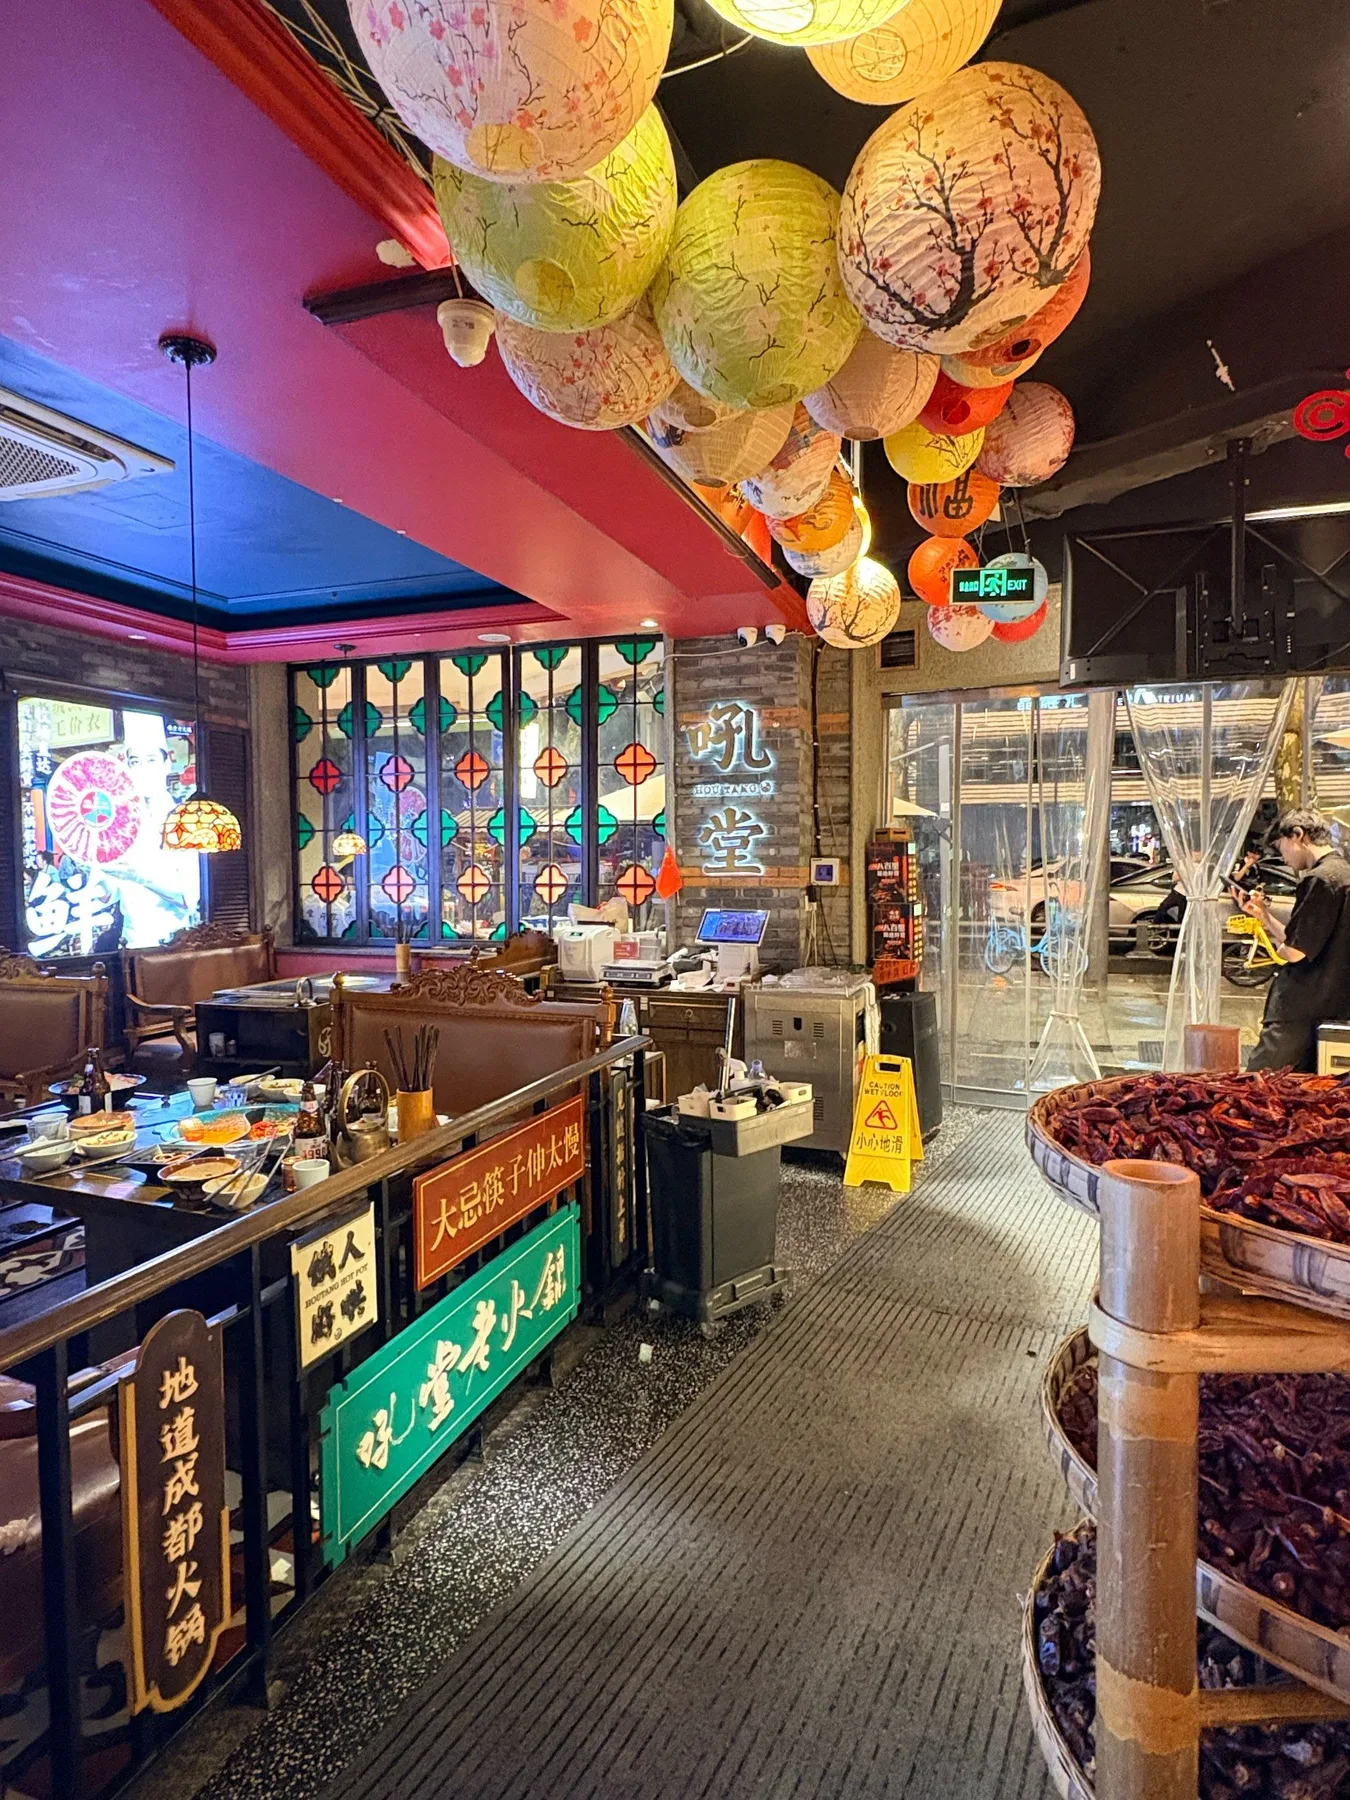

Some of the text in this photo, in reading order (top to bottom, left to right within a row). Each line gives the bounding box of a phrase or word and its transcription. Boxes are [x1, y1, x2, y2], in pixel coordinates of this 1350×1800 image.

[1007, 579, 1027, 591] EXIT
[687, 703, 772, 770] 吼
[694, 784, 758, 795] HOU TANG
[700, 807, 764, 874] 堂
[26, 870, 115, 958] 鲜
[864, 1088, 879, 1096] WET
[856, 1132, 903, 1154] 小心地滑
[430, 1122, 580, 1252] 大忌筷子伸太慢
[305, 1263, 368, 1309] HOUTANG HOT POT
[158, 1356, 206, 1668] 地道成都火锅
